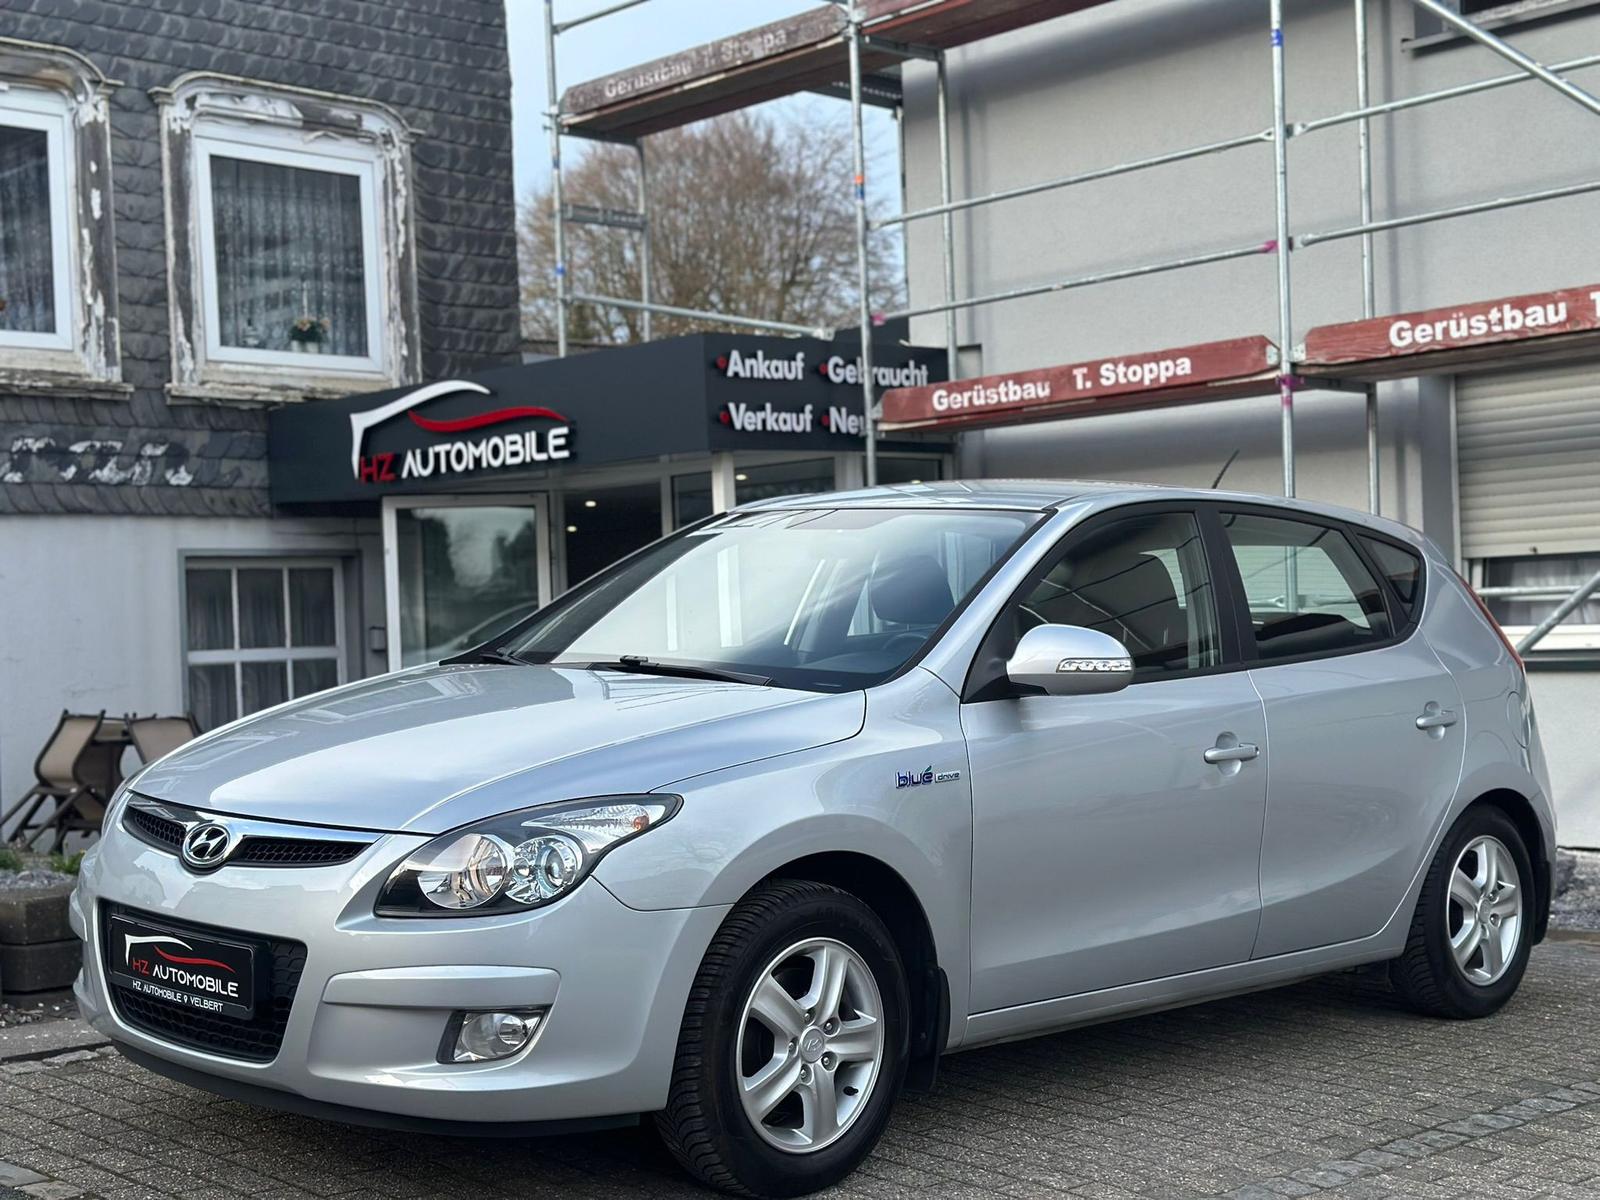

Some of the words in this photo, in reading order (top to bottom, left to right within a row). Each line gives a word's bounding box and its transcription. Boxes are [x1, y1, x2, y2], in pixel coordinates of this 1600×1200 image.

[720, 29, 787, 62] Stopa
[1389, 302, 1567, 347] Gerüstbau
[727, 349, 805, 381] Ankauf
[932, 379, 1051, 412] Gerüstbau
[1073, 367, 1092, 391] T.
[1099, 356, 1192, 387] Stoppa
[728, 402, 813, 433] Verkauf
[360, 452, 396, 483] HZ
[401, 426, 570, 479] AUTOMOBILE
[937, 772, 960, 781] drive
[132, 958, 149, 975] HZ
[152, 964, 239, 998] AUTOMOBILE
[132, 980, 142, 991] HZ
[143, 982, 182, 1002] AUTOMOBILE
[190, 996, 224, 1013] VELBERT
